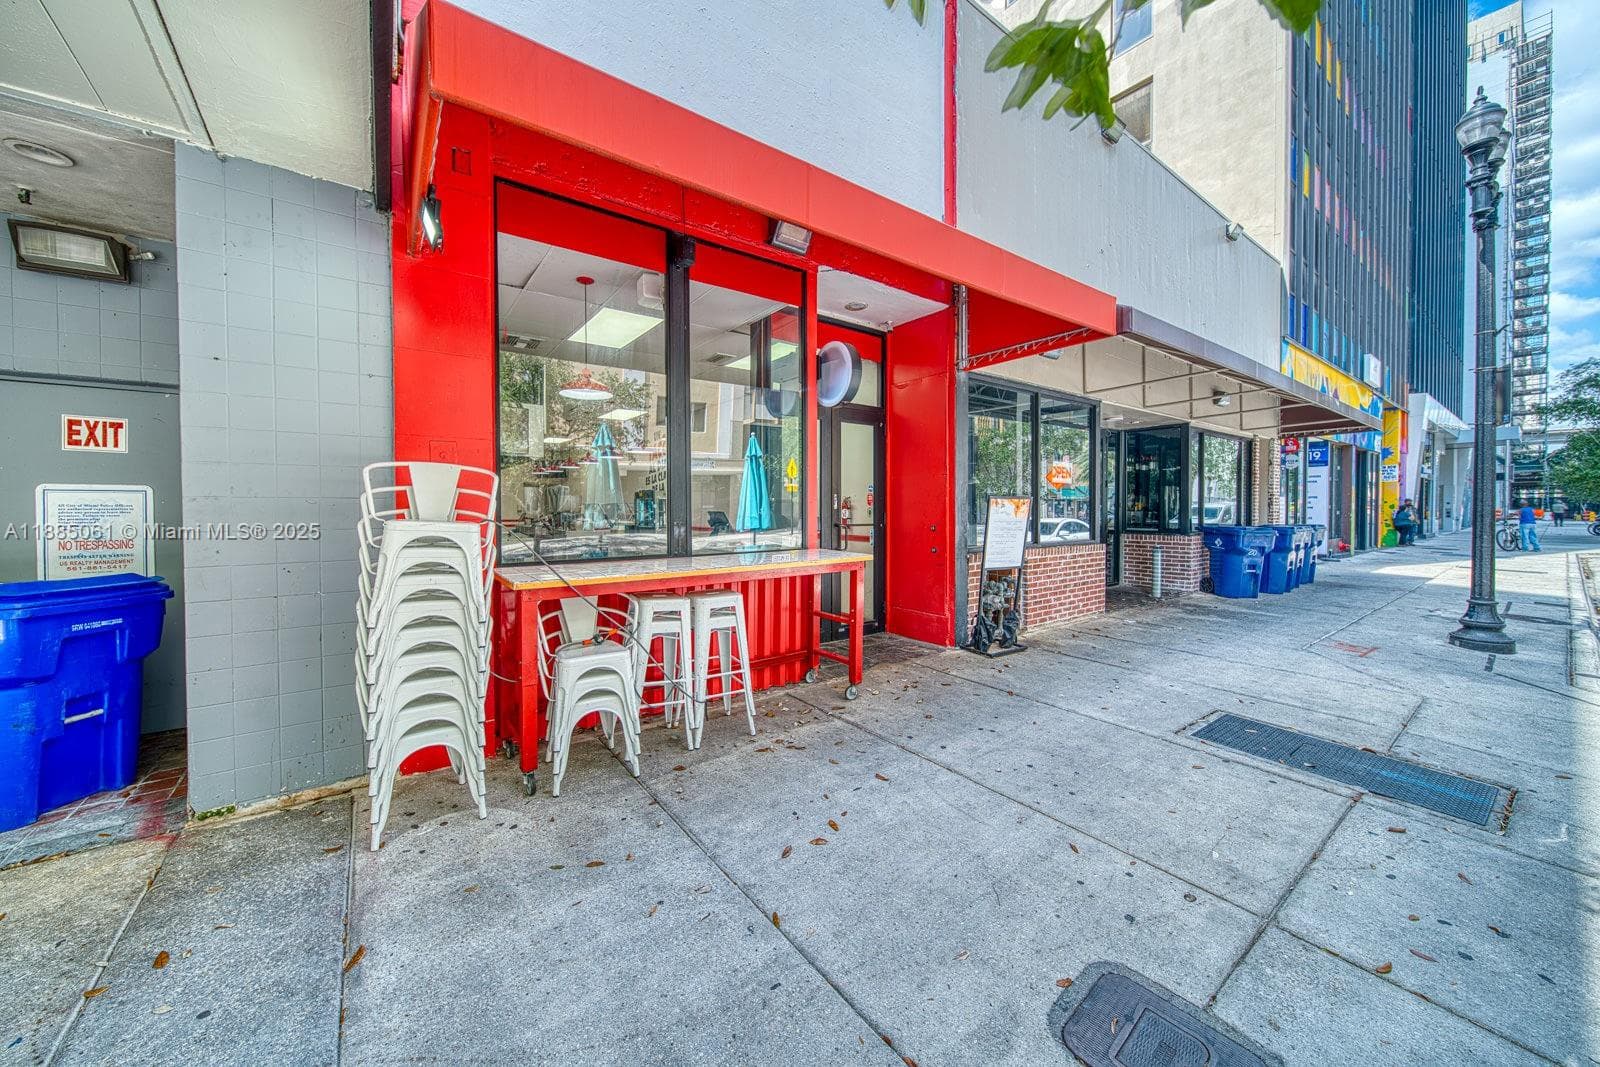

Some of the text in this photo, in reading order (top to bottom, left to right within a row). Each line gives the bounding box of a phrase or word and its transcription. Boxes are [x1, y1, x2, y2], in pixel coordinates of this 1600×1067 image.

[67, 418, 124, 448] EXIT
[58, 539, 134, 551] NO TRESPASSING
[94, 558, 134, 566] MANAGEMENT
